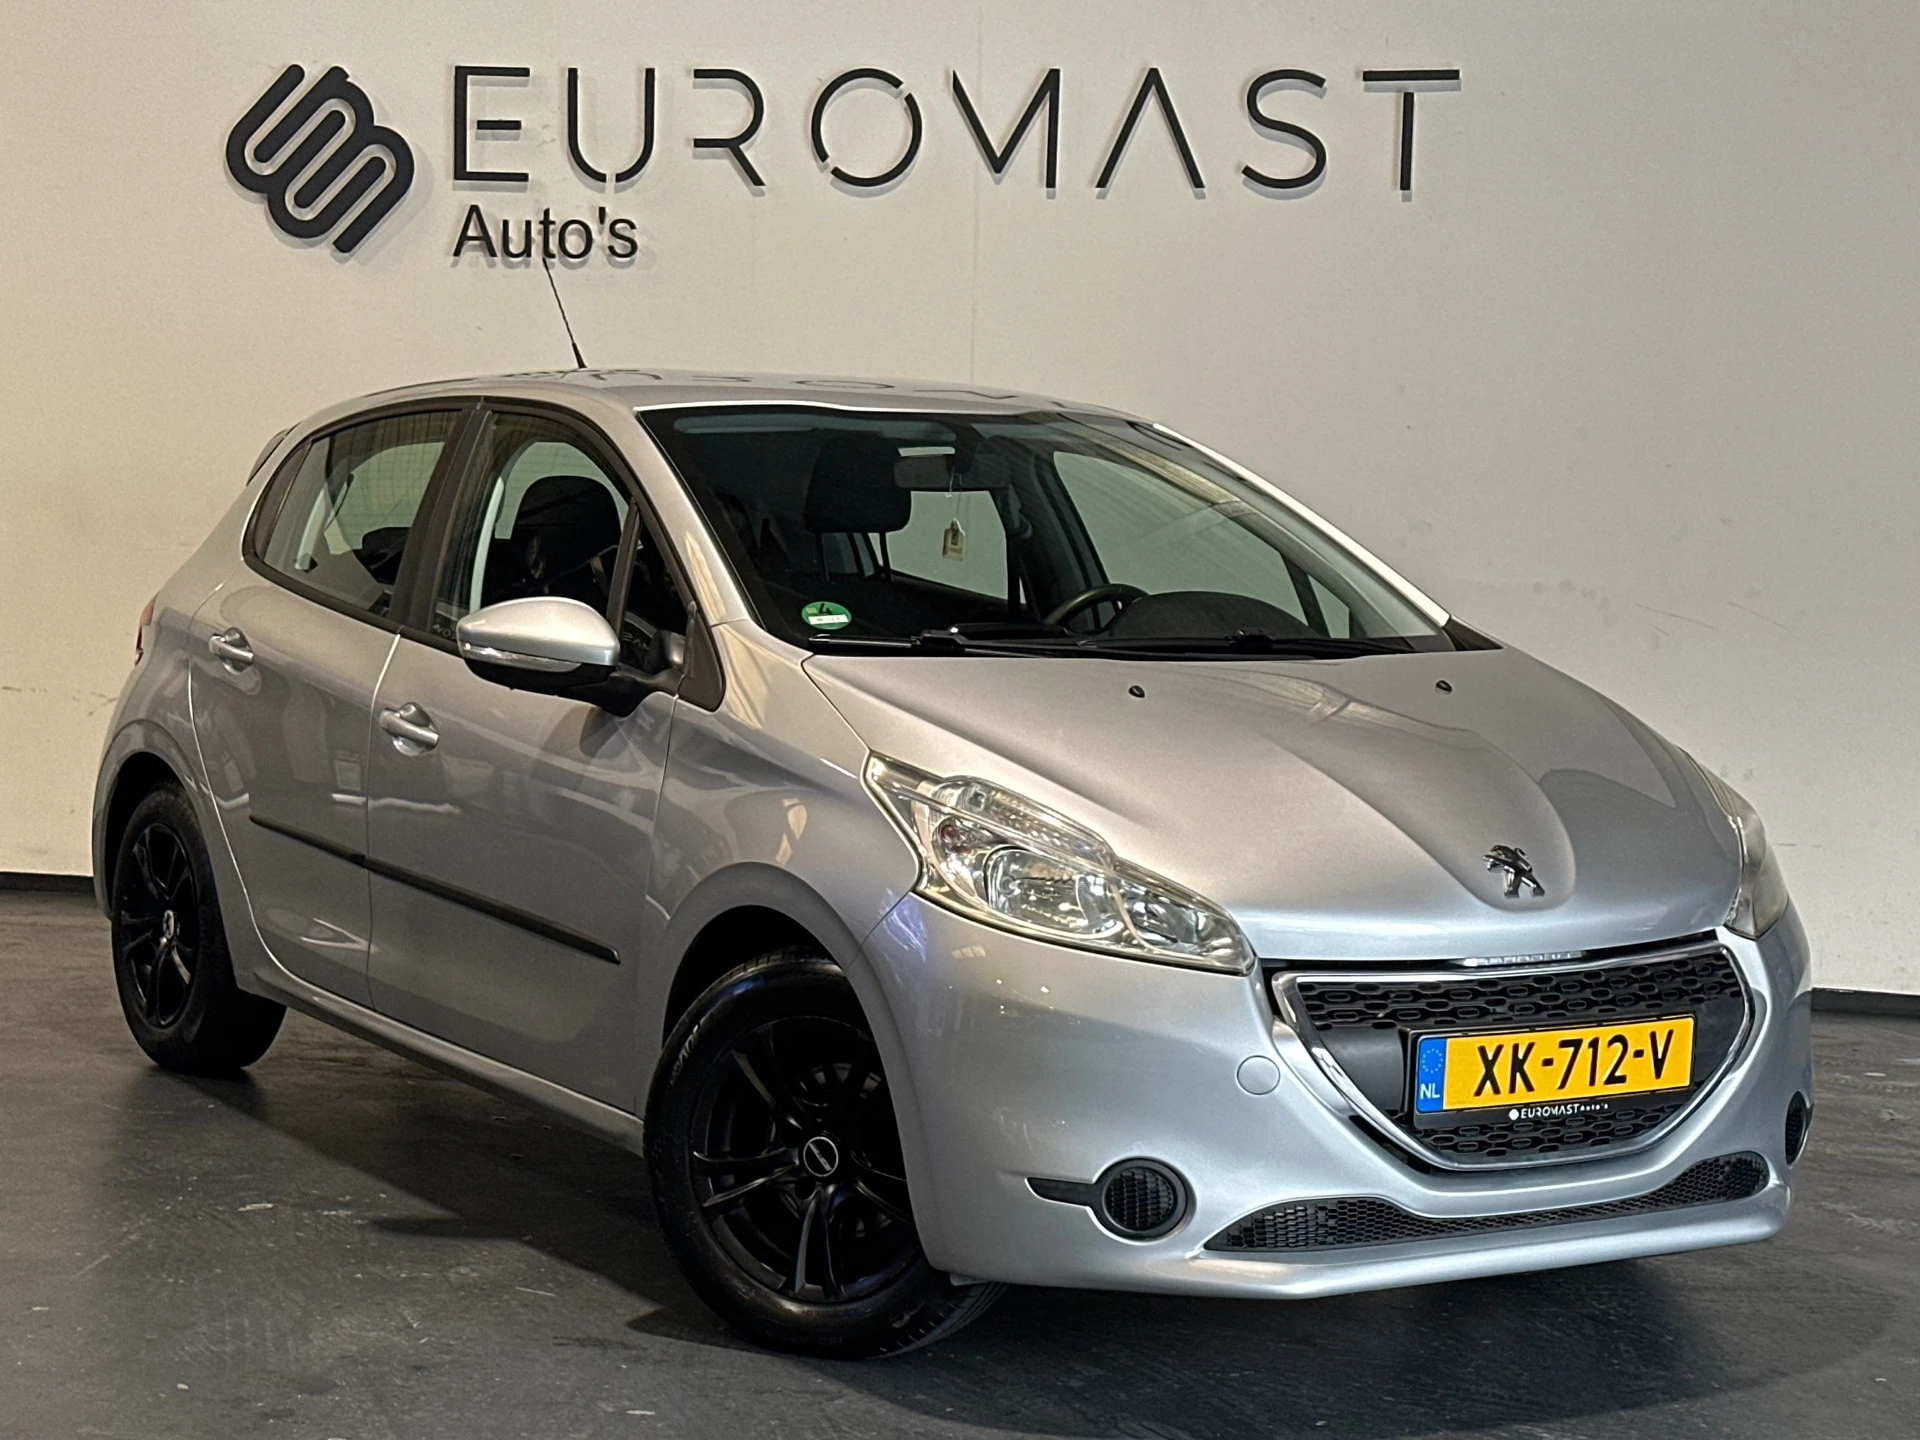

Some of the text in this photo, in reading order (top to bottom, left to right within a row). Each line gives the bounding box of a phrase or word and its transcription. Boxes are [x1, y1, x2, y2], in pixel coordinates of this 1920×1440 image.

[453, 65, 1460, 191] EUROMAST
[452, 204, 638, 259] Auto's
[1473, 1028, 1674, 1097] XK-712-V
[1420, 1083, 1441, 1100] NL
[1520, 1103, 1580, 1119] EUROMAST
